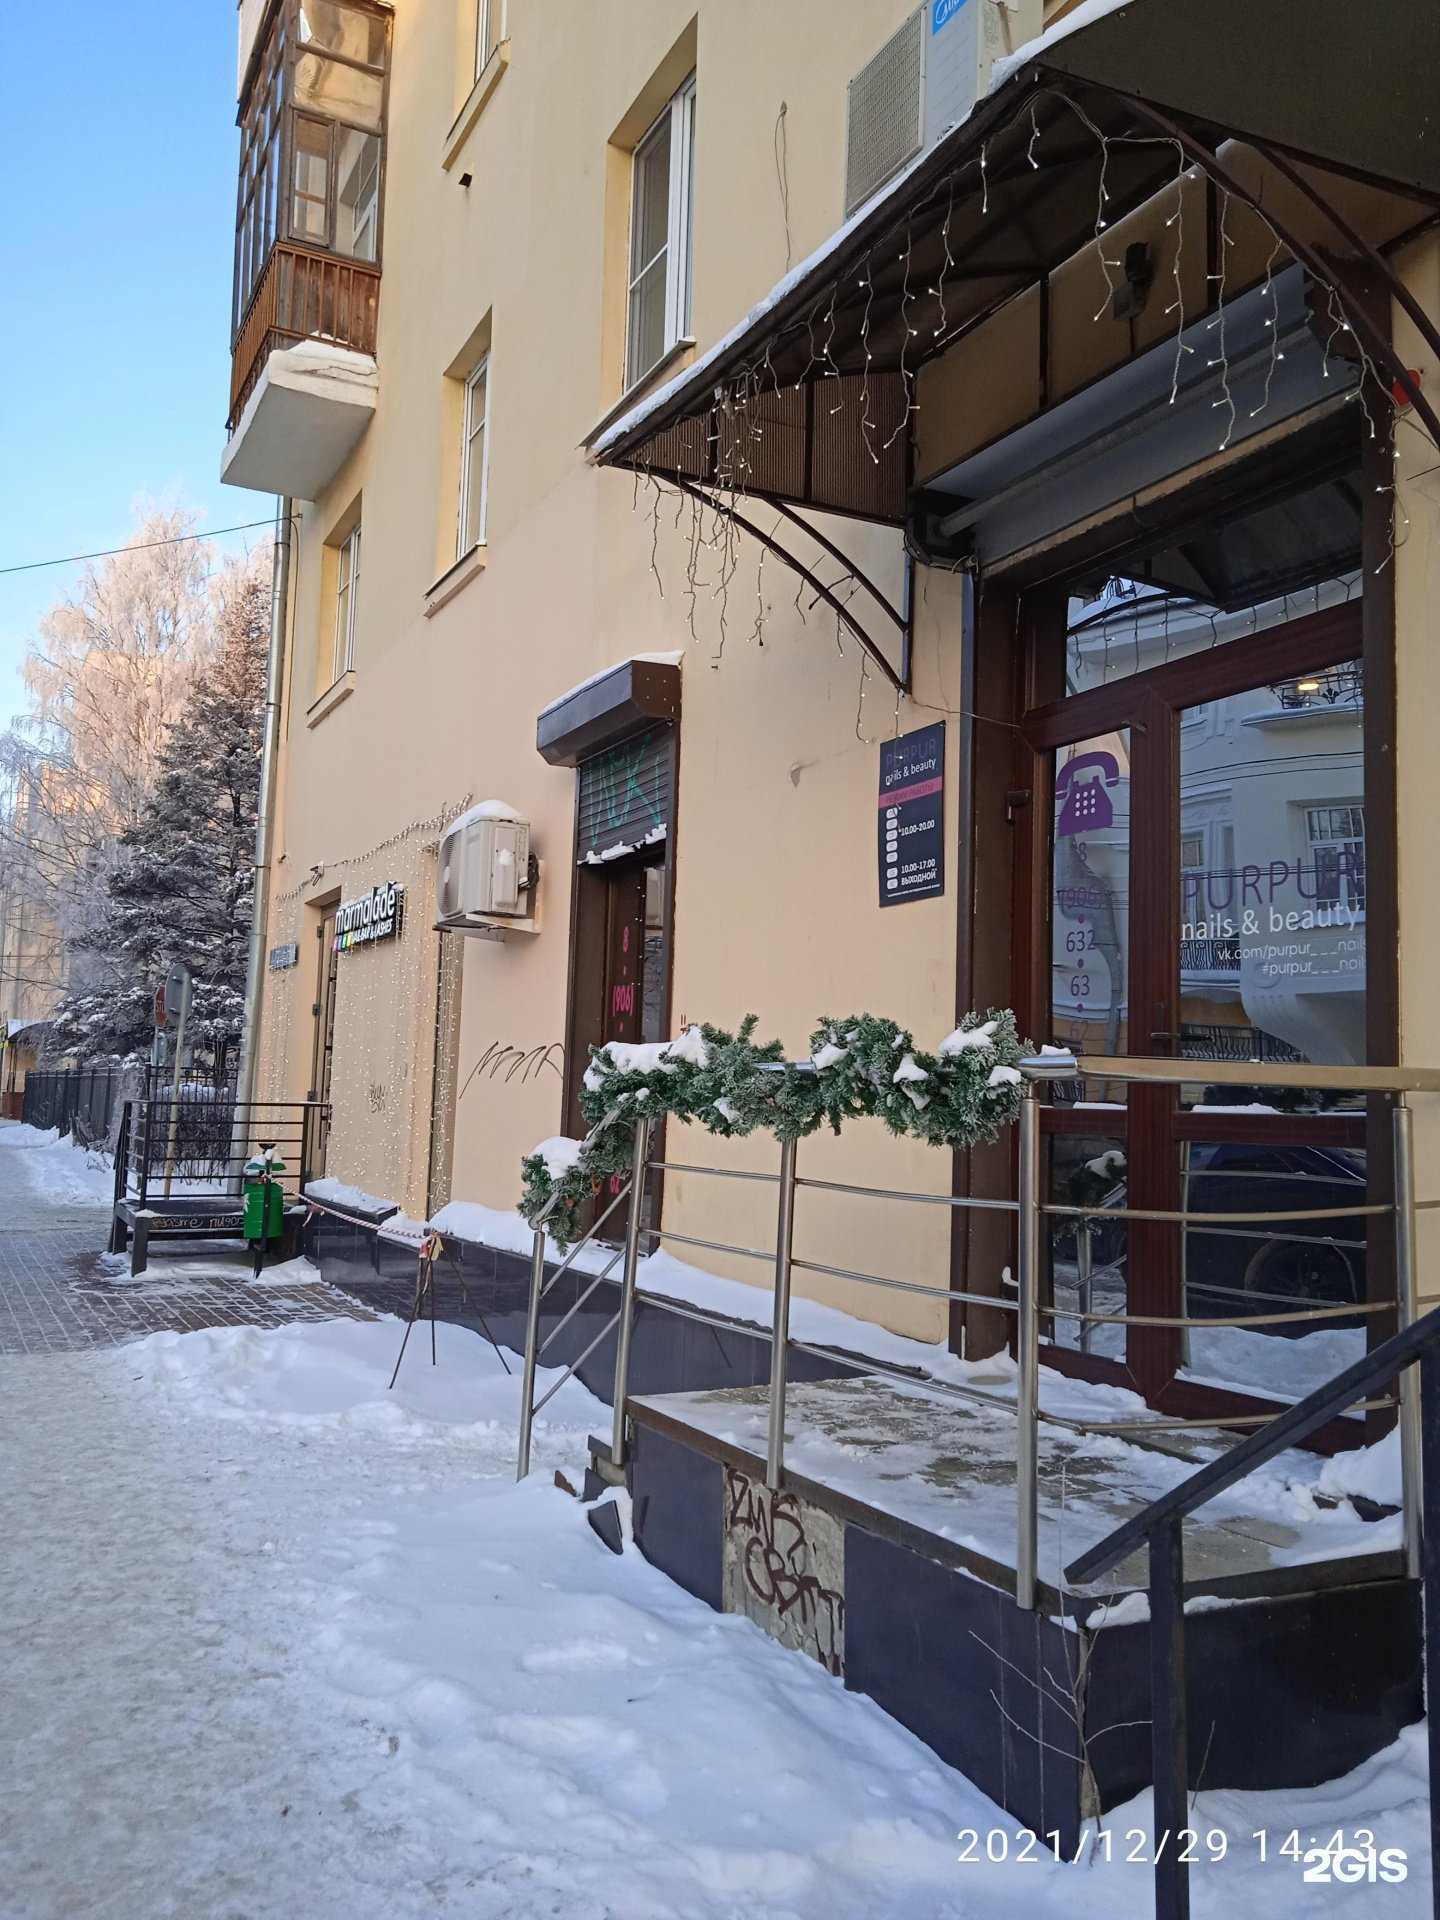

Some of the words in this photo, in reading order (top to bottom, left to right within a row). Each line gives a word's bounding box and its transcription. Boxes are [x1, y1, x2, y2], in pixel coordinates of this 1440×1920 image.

[903, 766, 909, 777] &
[911, 758, 936, 774] beauty
[1182, 850, 1364, 914] PURPUR
[335, 882, 395, 934] marmalade
[1181, 914, 1233, 941] nails
[1241, 909, 1260, 935] &
[1269, 902, 1361, 932] beauty
[1066, 930, 1096, 952] 632
[1071, 975, 1090, 996] 63
